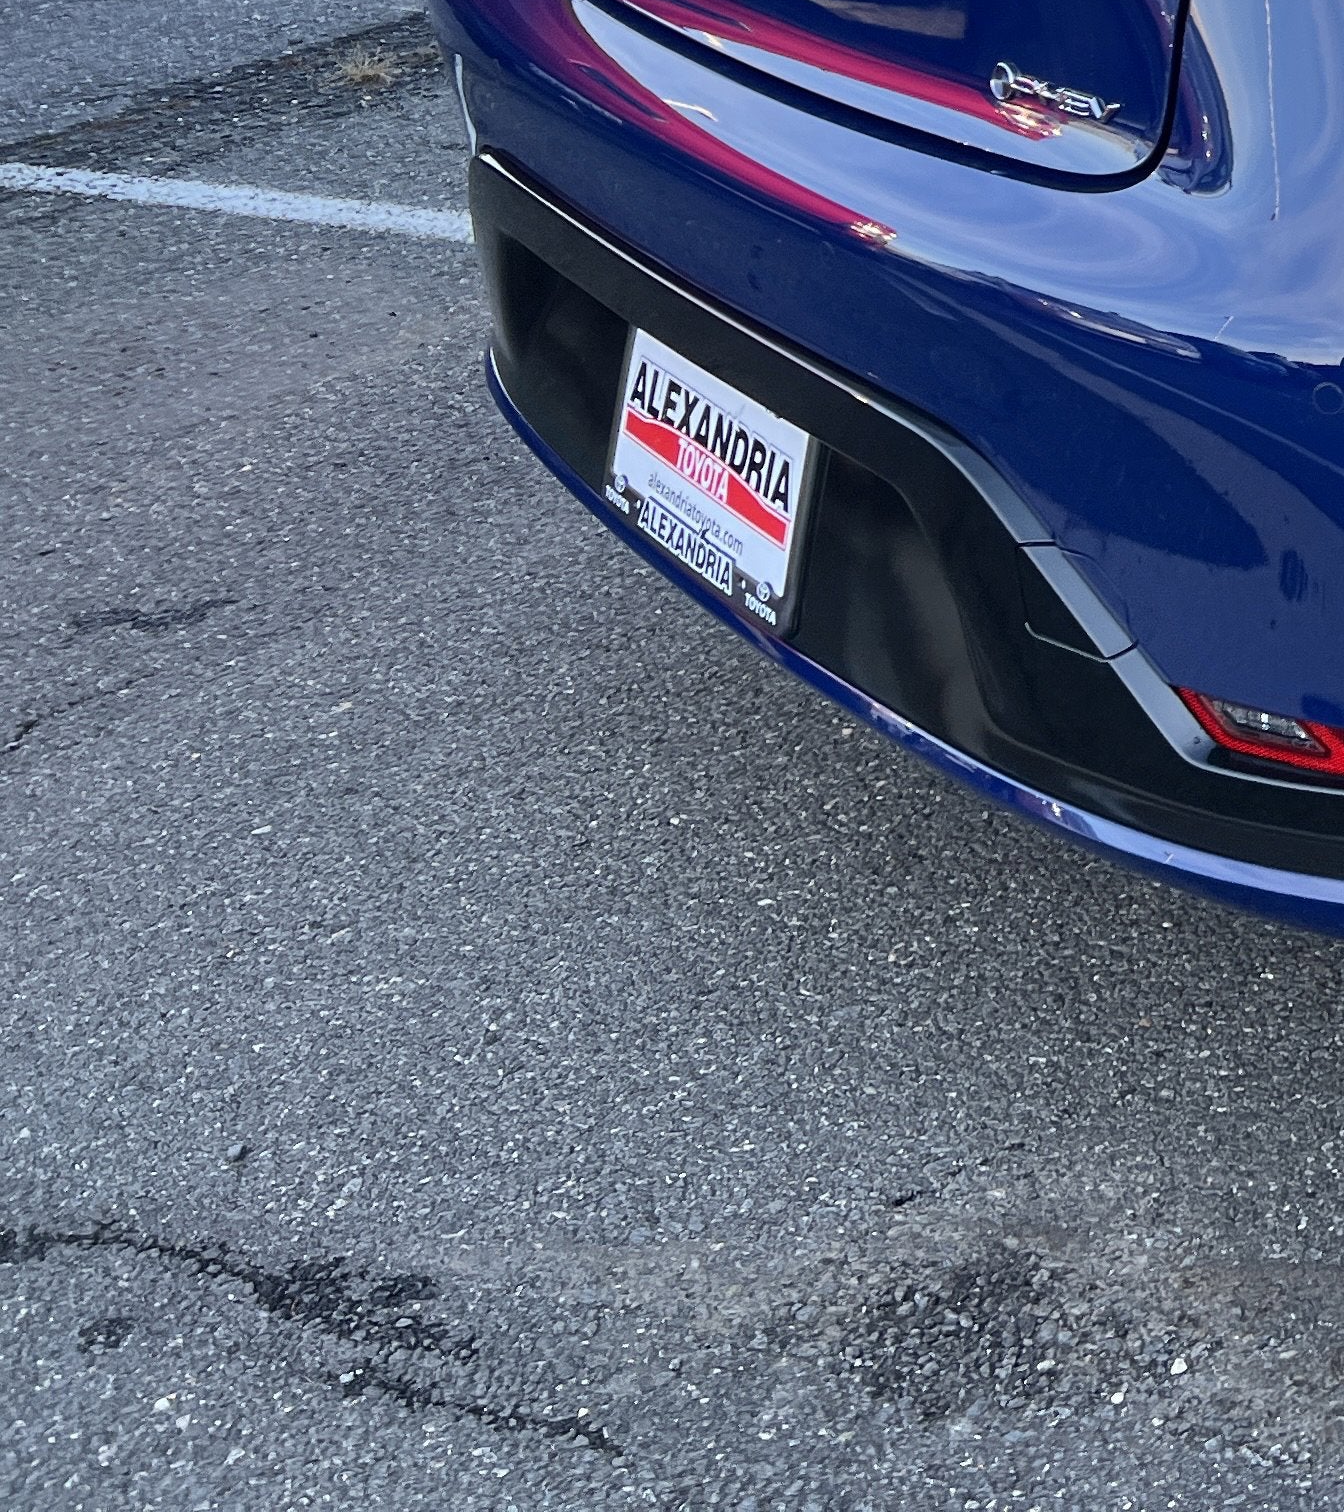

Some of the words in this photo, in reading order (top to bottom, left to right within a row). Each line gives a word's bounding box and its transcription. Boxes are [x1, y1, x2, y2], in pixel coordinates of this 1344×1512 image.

[629, 360, 792, 514] ALEXANDRIA
[675, 438, 730, 505] TOYOTA
[605, 484, 630, 515] TOYOTA
[647, 470, 744, 556] alexandriatoyota.com
[637, 499, 734, 596] ALEXANDRIA
[744, 592, 777, 626] TOYOTA
